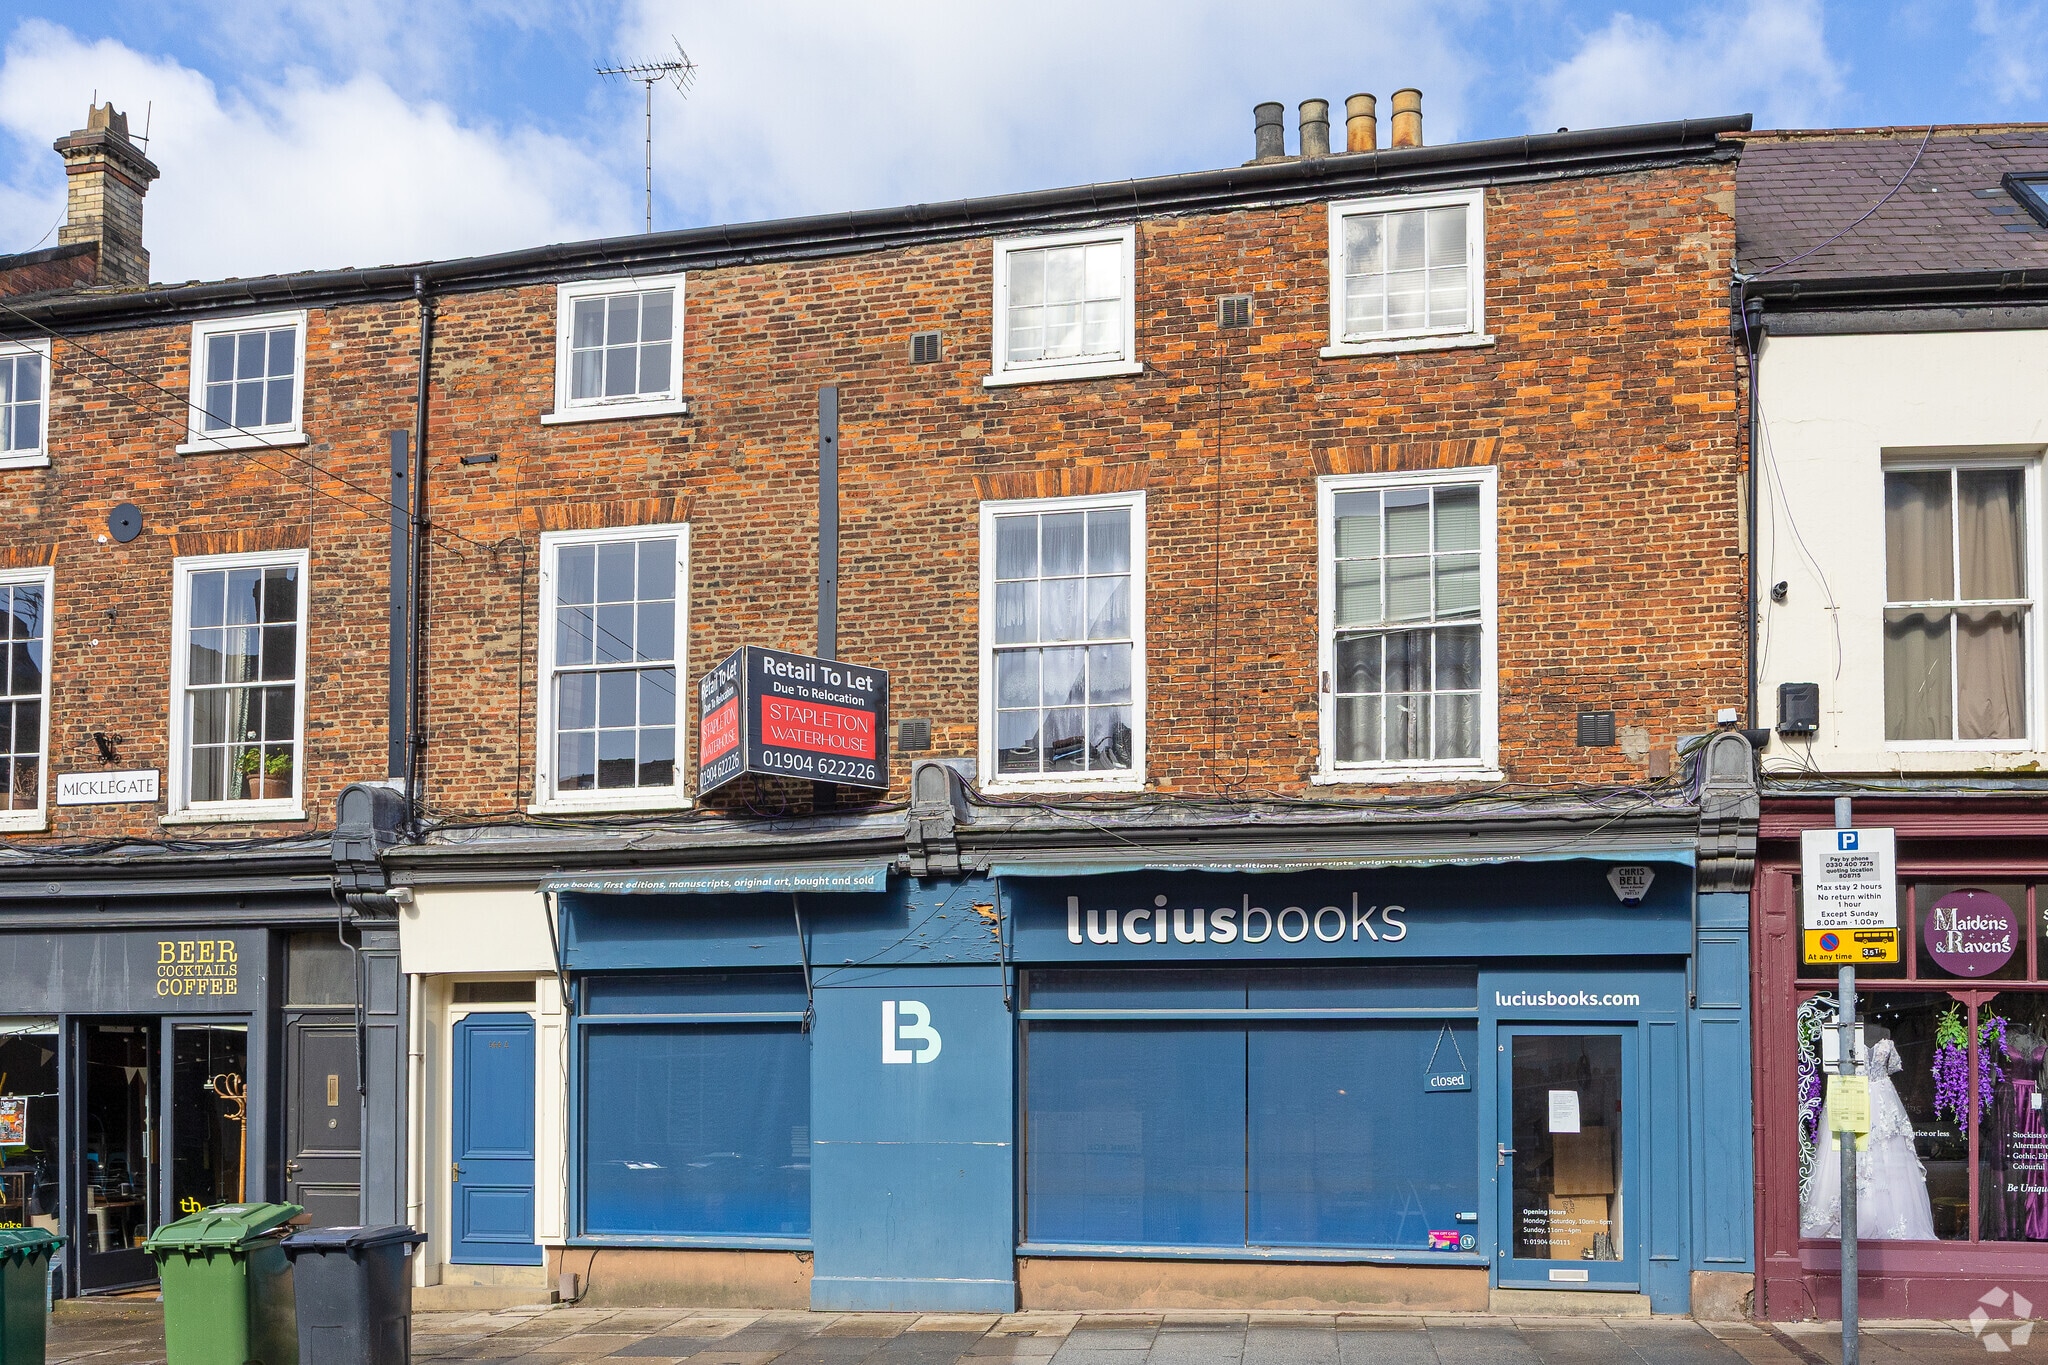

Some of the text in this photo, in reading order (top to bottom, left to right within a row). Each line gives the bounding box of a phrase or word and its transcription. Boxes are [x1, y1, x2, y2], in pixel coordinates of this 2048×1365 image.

[719, 669, 726, 687] To
[727, 660, 737, 681] Let
[763, 656, 873, 692] Retail To Let
[773, 682, 864, 706] Due To Relocation
[702, 706, 736, 741] STAPLETON
[770, 703, 868, 733] STAPLETON
[701, 728, 736, 758] WATERHOUSE
[771, 725, 867, 752] WATERHOUSE
[700, 751, 739, 788] 01904 622226
[763, 750, 875, 779] 01904 622226
[63, 779, 153, 796] MICKLEGATE
[1842, 834, 1855, 849] P
[571, 881, 600, 889] books,
[604, 881, 623, 889] first
[626, 881, 666, 889] editions,
[669, 879, 732, 889] manuscripts,
[734, 878, 771, 888] original
[774, 878, 791, 887] art,
[794, 876, 829, 887] bought
[832, 876, 850, 885] and
[854, 876, 874, 885] sold
[1619, 876, 1645, 885] BELL
[1067, 891, 1407, 944] luciusbooks
[1934, 907, 2008, 931] Maidens
[157, 940, 238, 963] BEER
[157, 964, 237, 977] COCKTAILS
[157, 978, 237, 996] COFFEE
[1495, 991, 1640, 1006] luciusbooks.com
[882, 1000, 942, 1064] LB
[1431, 1074, 1464, 1086] closed
[2012, 1162, 2045, 1170] Colourful
[2007, 1183, 2018, 1191] Be
[180, 1197, 206, 1214] th
